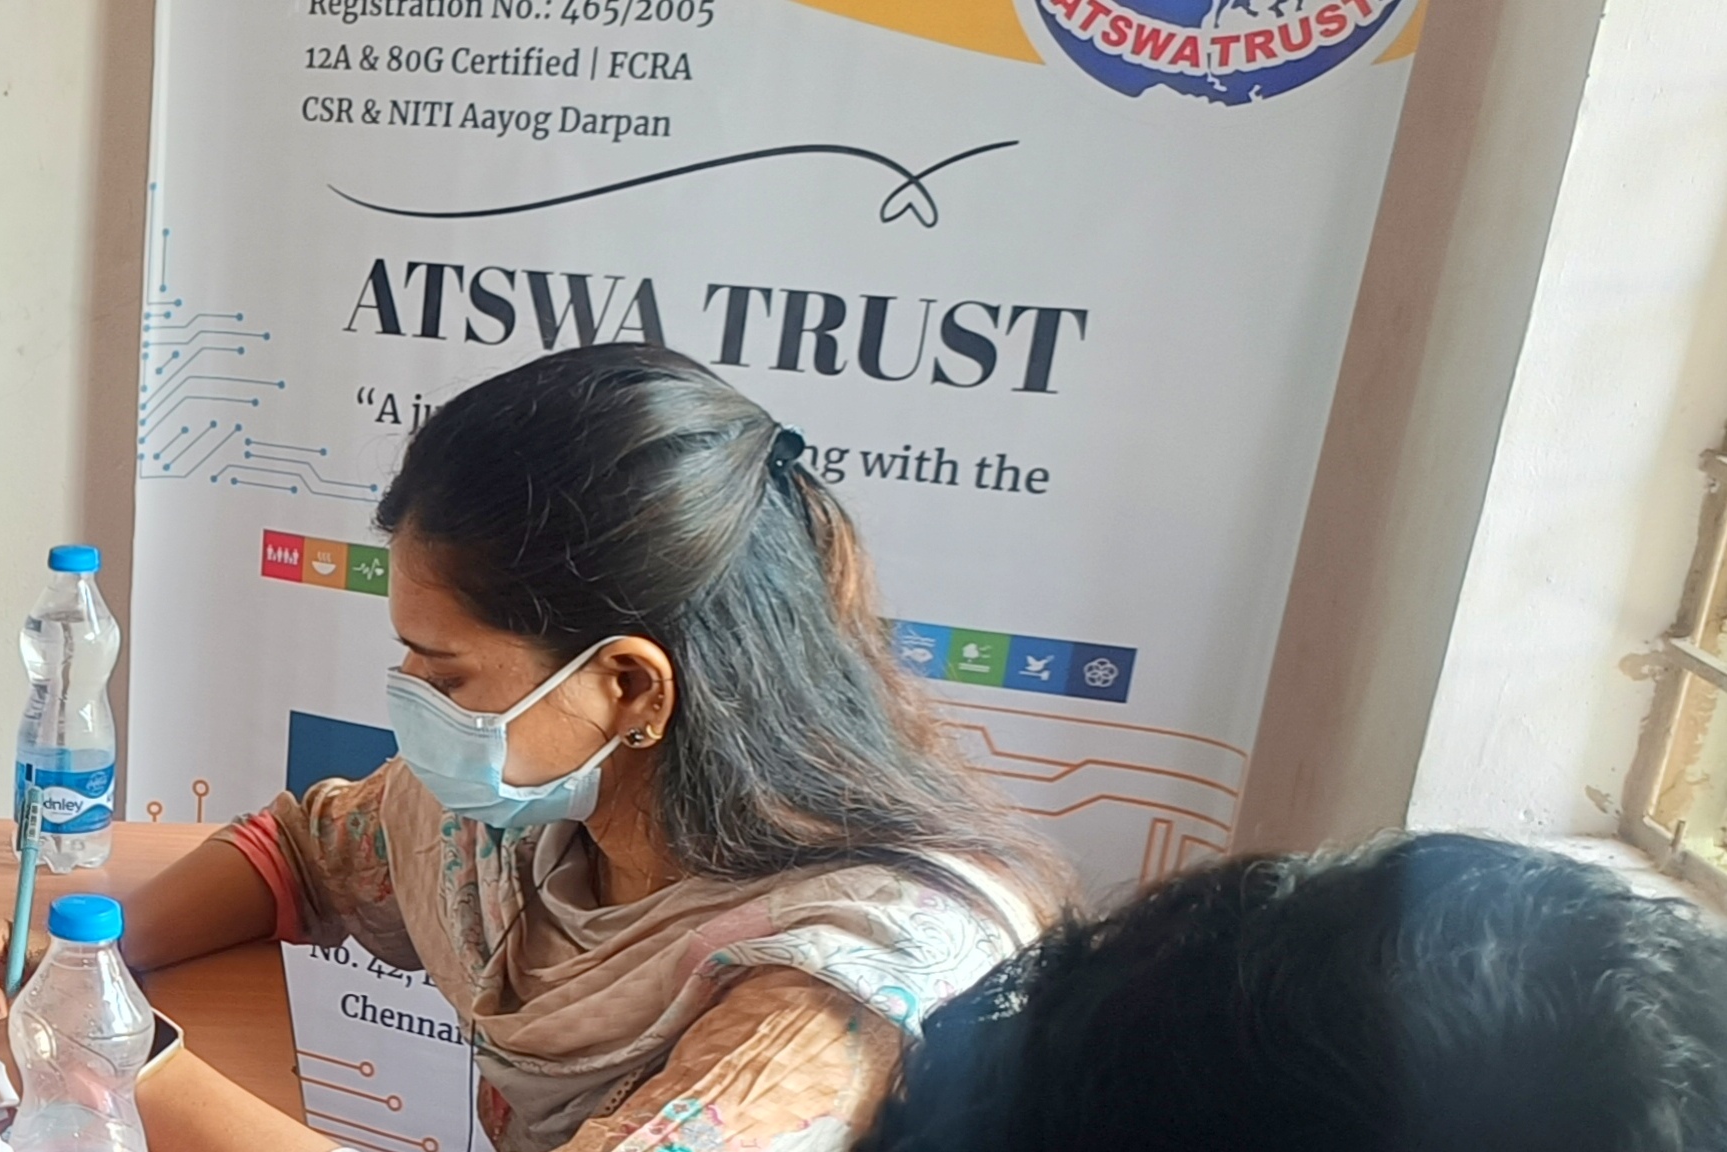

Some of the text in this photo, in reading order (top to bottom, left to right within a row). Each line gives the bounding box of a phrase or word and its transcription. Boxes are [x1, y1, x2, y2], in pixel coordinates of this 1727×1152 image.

[308, 0, 484, 24] Registration
[561, 0, 715, 27] 465/2005
[1049, 0, 1373, 68] ATSWA TRUST
[305, 45, 352, 71] 12A
[359, 45, 380, 72] &
[387, 46, 444, 74] 80G
[451, 47, 579, 78] Certified
[608, 52, 693, 81] FCRA
[302, 97, 671, 143] CSR & NITI Aayog Darpan
[343, 257, 1089, 395] ATSWA TRUST
[860, 444, 960, 486] with
[974, 453, 1050, 494] the
